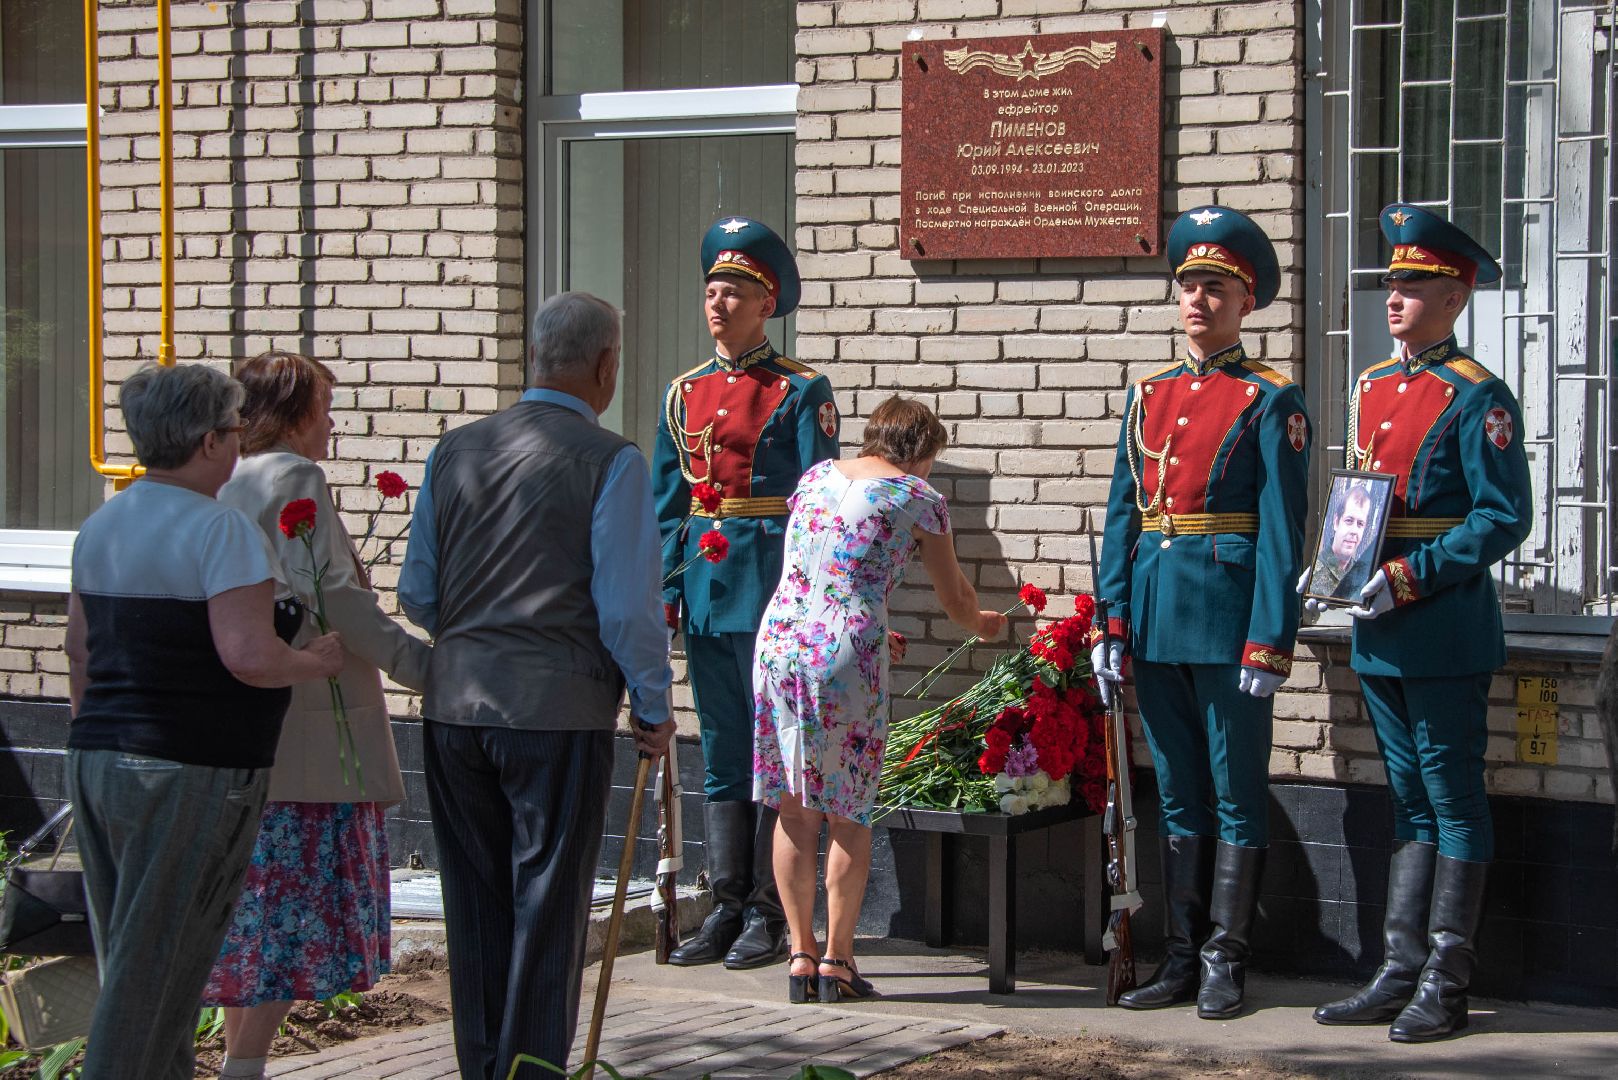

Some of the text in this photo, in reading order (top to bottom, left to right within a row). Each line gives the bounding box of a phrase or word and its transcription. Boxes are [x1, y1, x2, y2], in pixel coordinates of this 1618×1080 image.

[983, 86, 1073, 99] В этом доме жил
[998, 102, 1059, 116] ефрейтор
[990, 121, 1066, 138] ПИМЕНОВ
[957, 141, 1100, 160] Юрий Алексеевич
[971, 163, 1023, 176] 03.09.1994
[1032, 162, 1084, 175] 23.01.2023
[915, 188, 1142, 202] Погиб при исполнении воинского долга
[915, 201, 1142, 216] в ходе Специальной Военной Операции.
[915, 215, 1142, 230] Посмертно награждён Орденом Мужества.
[1541, 678, 1557, 689] 150
[1539, 690, 1558, 703] 100
[1530, 740, 1547, 755] 9.7
